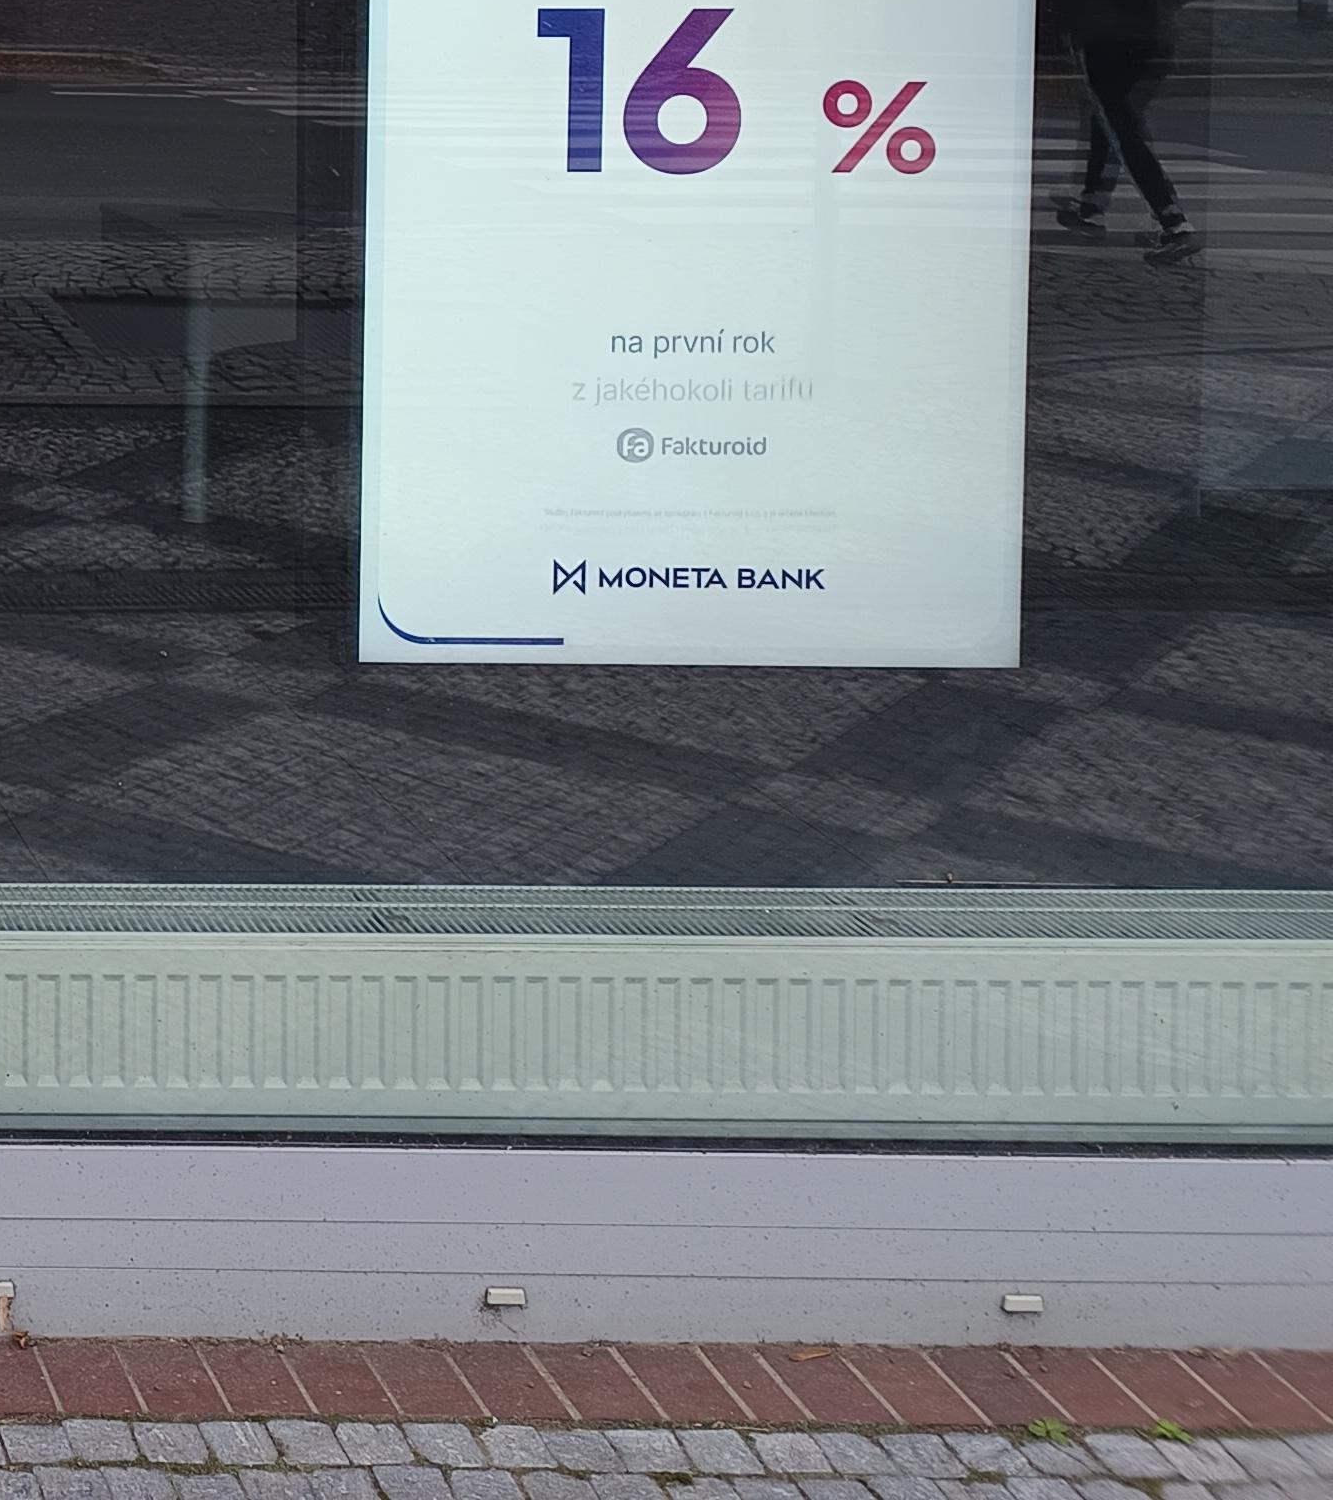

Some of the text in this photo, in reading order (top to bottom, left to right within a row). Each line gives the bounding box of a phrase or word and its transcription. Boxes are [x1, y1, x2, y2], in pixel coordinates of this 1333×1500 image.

[535, 6, 938, 177] 16 %
[652, 327, 726, 361] první
[731, 329, 776, 355] rok
[570, 373, 815, 408] z jakéhokoli tarifu
[661, 436, 767, 456] Fakturoid
[597, 566, 827, 591] MONETA BANK
